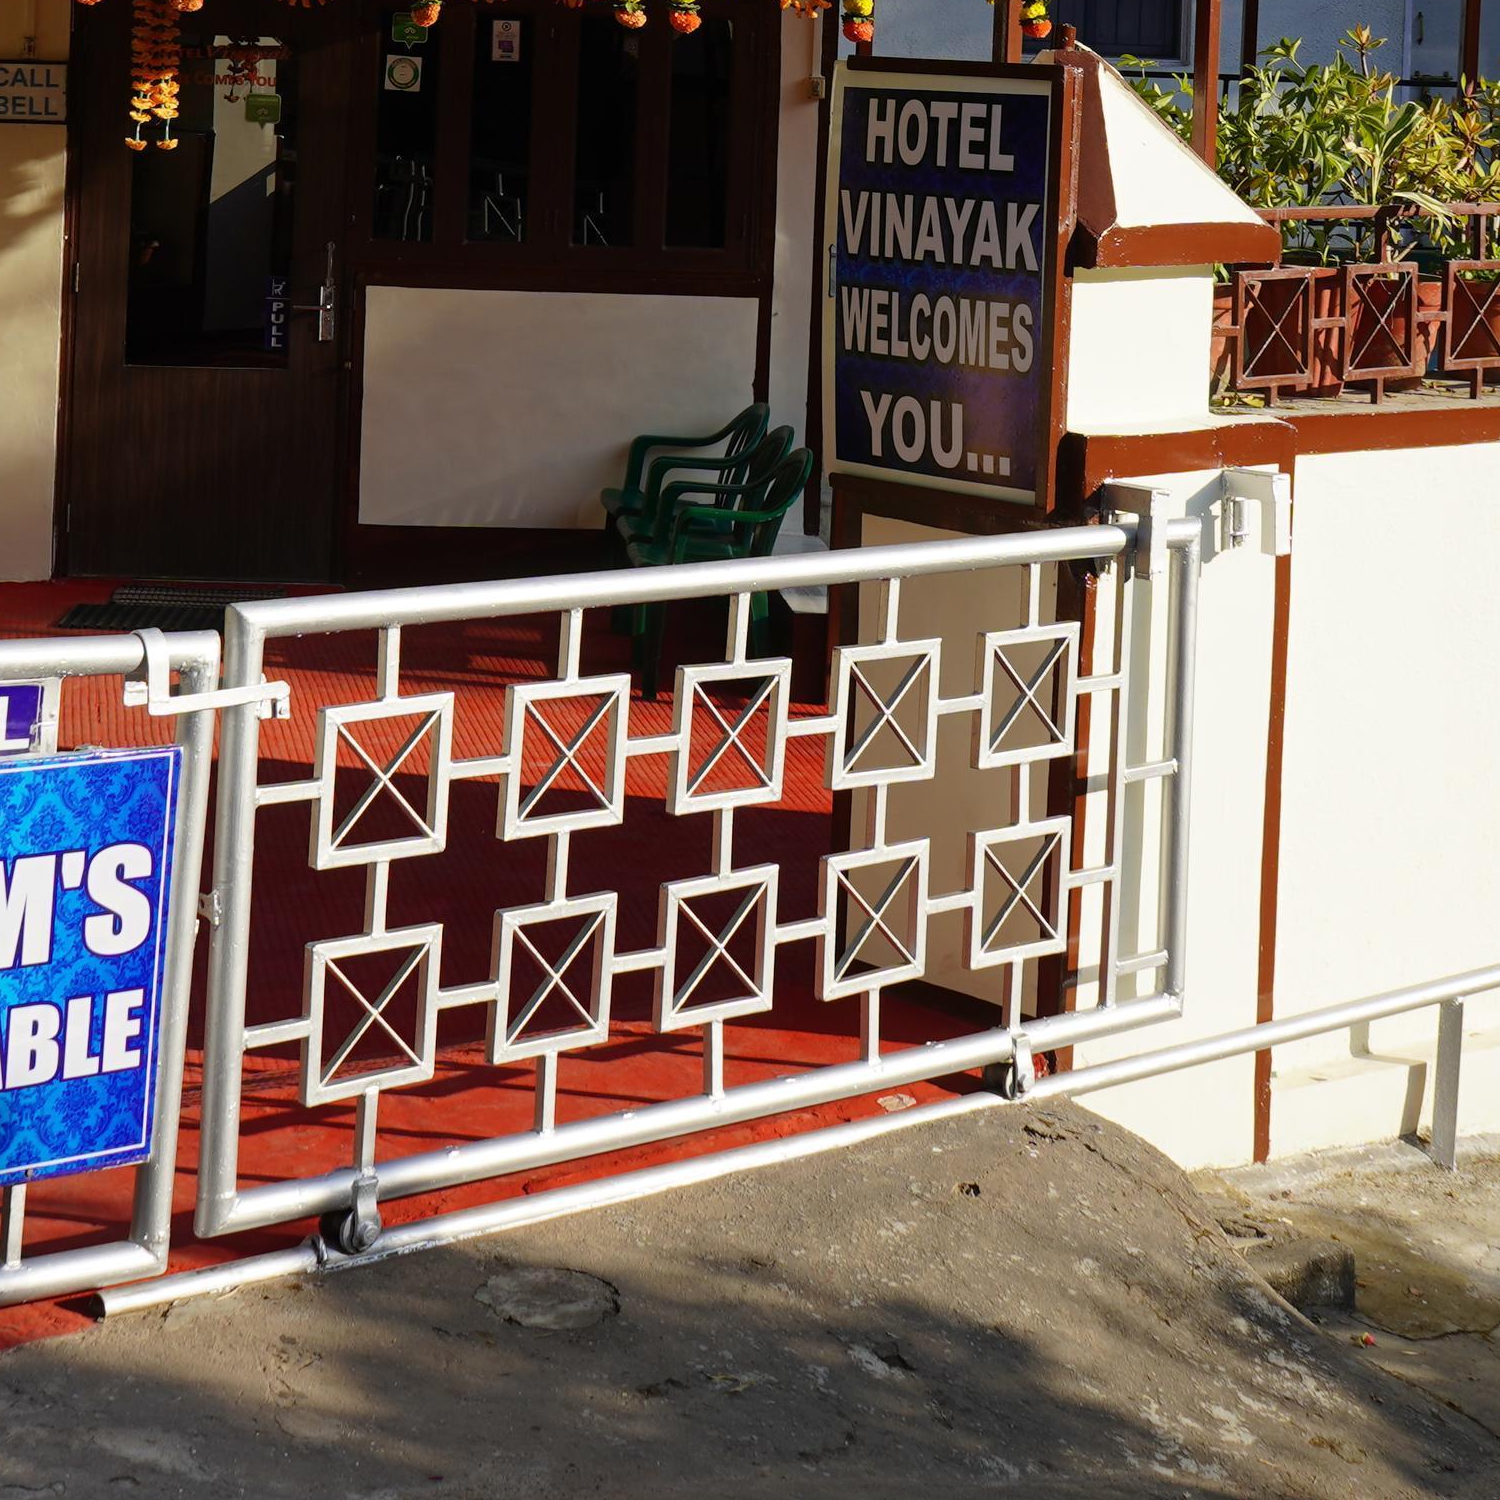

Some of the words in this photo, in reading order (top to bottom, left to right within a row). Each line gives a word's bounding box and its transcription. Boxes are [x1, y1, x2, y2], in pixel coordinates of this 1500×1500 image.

[865, 98, 1015, 171] HOTEL
[840, 190, 1040, 271] VINAYAK
[271, 301, 285, 348] PULL
[841, 286, 1034, 373] WELCOMES
[860, 390, 1011, 476] YOU...
